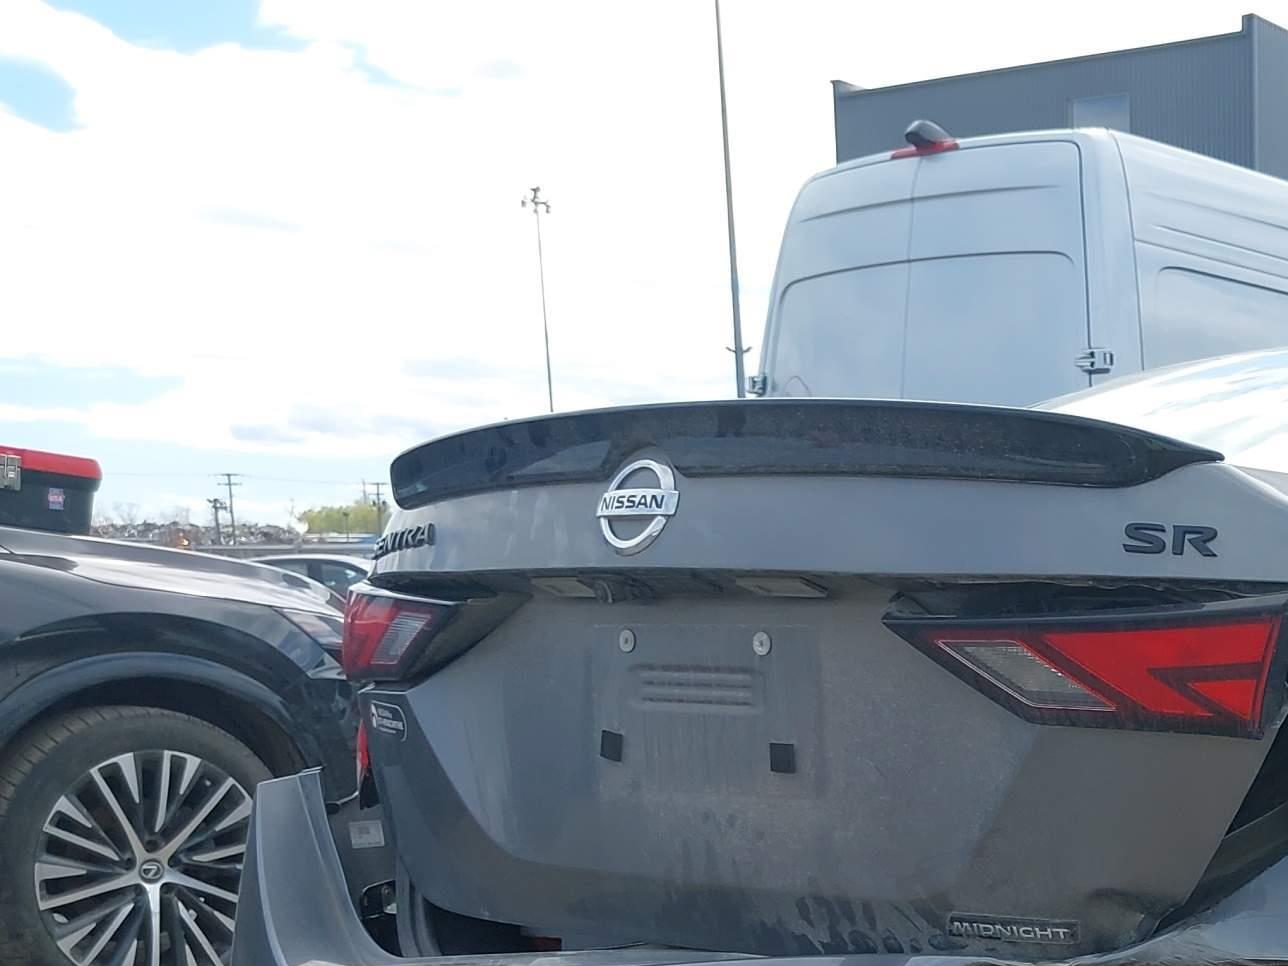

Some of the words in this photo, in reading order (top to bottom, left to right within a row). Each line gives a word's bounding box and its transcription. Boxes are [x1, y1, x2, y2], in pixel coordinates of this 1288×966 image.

[600, 494, 665, 512] NISSAN
[1122, 522, 1218, 557] SR
[952, 920, 1072, 940] MIDNIGHT
